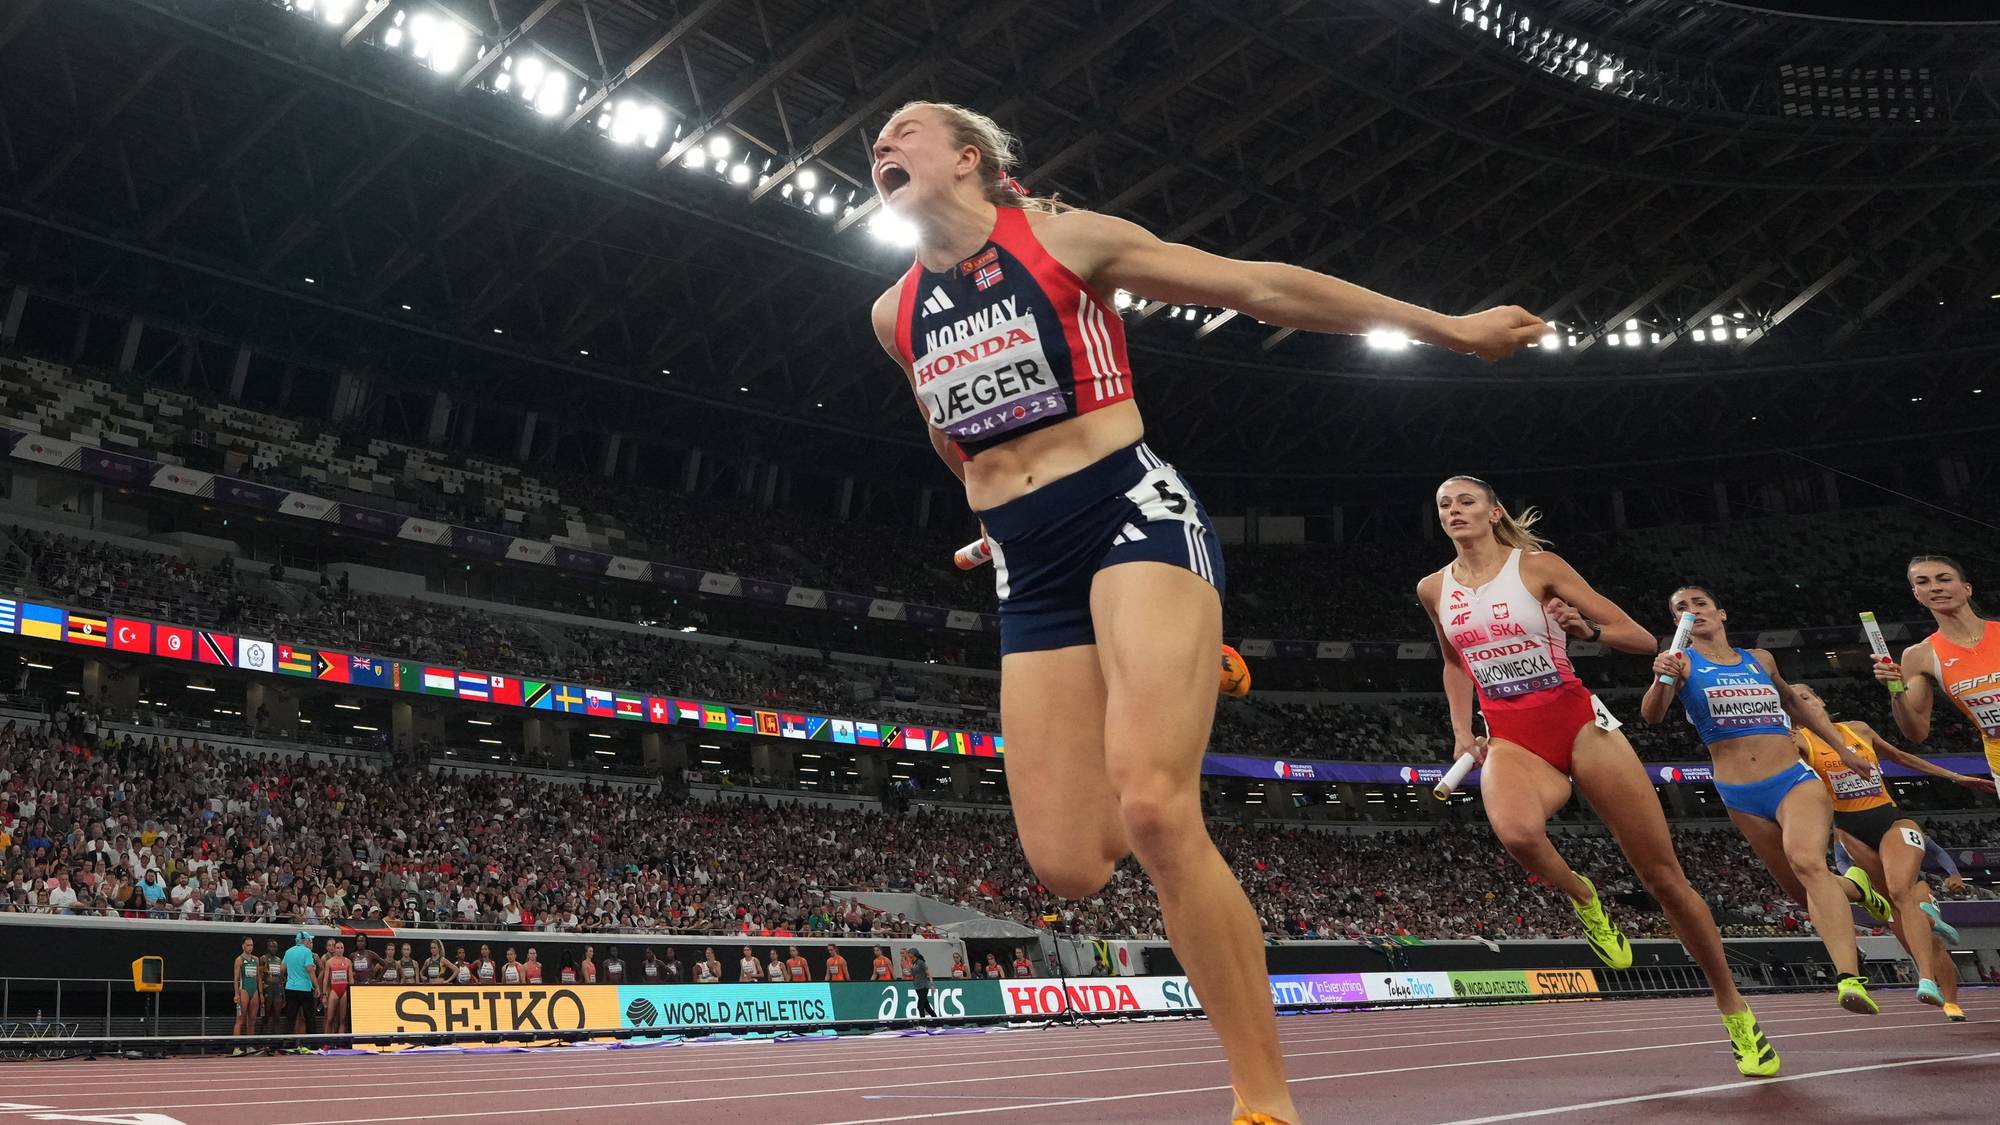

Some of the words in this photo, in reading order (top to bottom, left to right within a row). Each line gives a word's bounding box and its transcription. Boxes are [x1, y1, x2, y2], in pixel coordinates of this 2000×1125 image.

[925, 294, 1018, 353] NORWAY
[918, 328, 1036, 386] HONDA
[934, 359, 1046, 424] JÆGER
[1152, 480, 1187, 514] 5
[1450, 602, 1469, 610] ORLEN
[1465, 639, 1541, 663] HONDA
[1707, 687, 1776, 698] HONDA
[1716, 677, 1760, 685] ITALIA
[1712, 701, 1779, 716] MANGIONE
[1909, 831, 1921, 845] 8
[1275, 981, 1318, 1004] TDK
[1384, 977, 1411, 996] Tokyo
[1408, 978, 1435, 998] Tokyo
[1466, 982, 1492, 995] WORLD
[1492, 981, 1528, 994] ATHLETICS
[1536, 972, 1589, 994] SEIKO
[395, 989, 586, 1032] SEIKO
[1007, 984, 1142, 1014] HONDA
[664, 1001, 731, 1025] WORLD
[735, 999, 826, 1023] ATHLETICS
